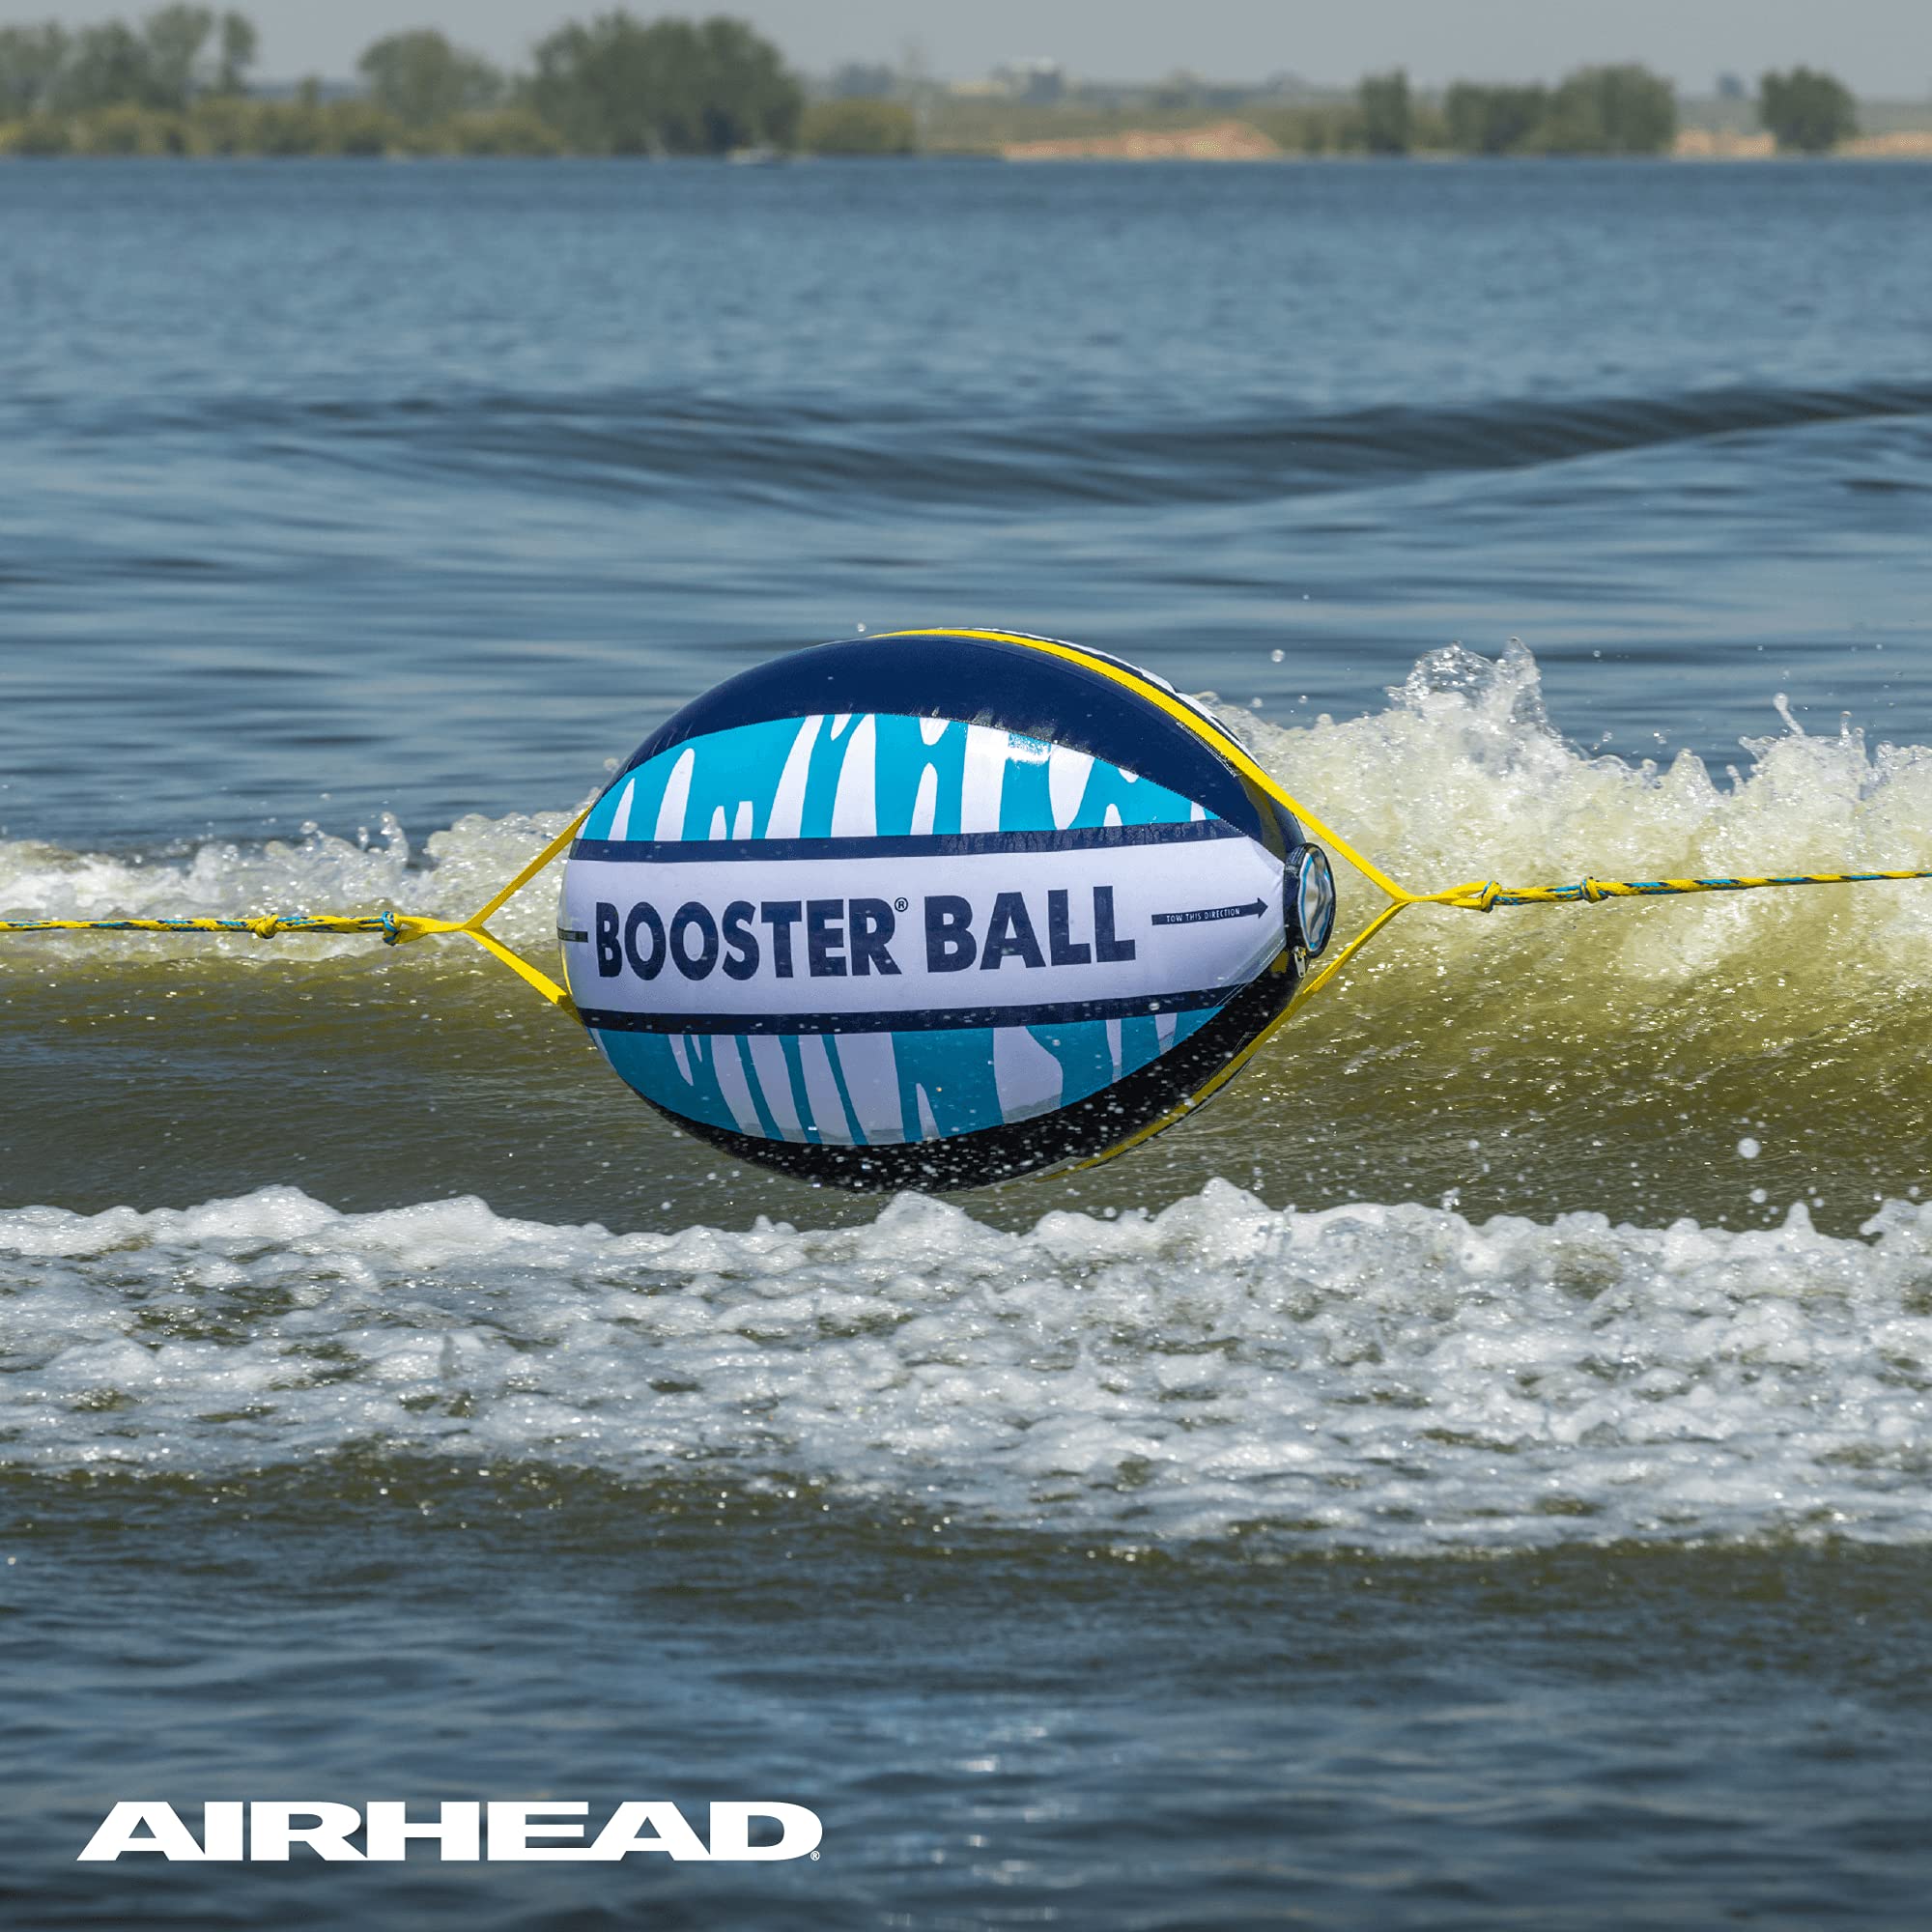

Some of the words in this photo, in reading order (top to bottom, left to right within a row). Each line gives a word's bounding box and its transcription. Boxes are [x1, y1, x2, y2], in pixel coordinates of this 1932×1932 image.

[924, 886, 1136, 974] BALL
[1185, 913, 1202, 922] THIS
[1204, 908, 1240, 920] DIRECTION
